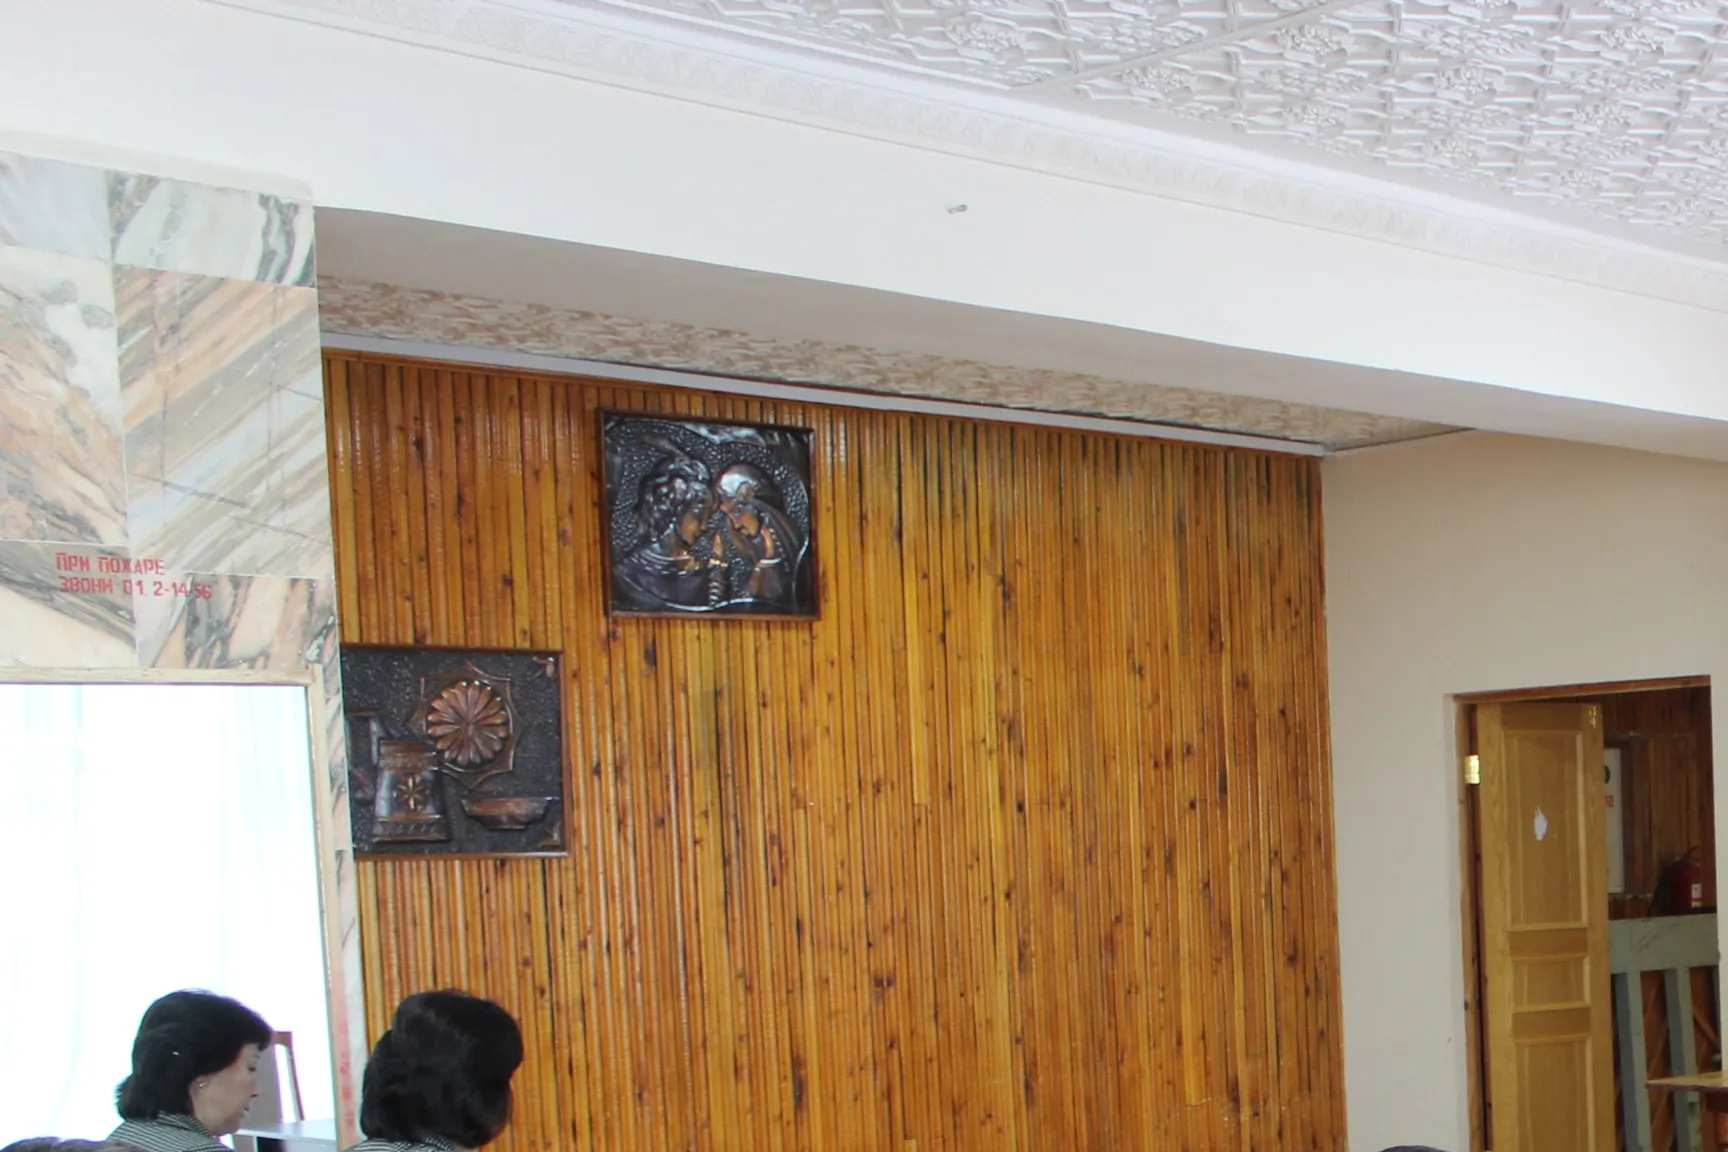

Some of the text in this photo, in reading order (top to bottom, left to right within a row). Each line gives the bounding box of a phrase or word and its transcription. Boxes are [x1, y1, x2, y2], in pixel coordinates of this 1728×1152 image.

[56, 552, 165, 575] ПРИ ПОЖАРЕ
[59, 575, 114, 594] ЗВОНИ
